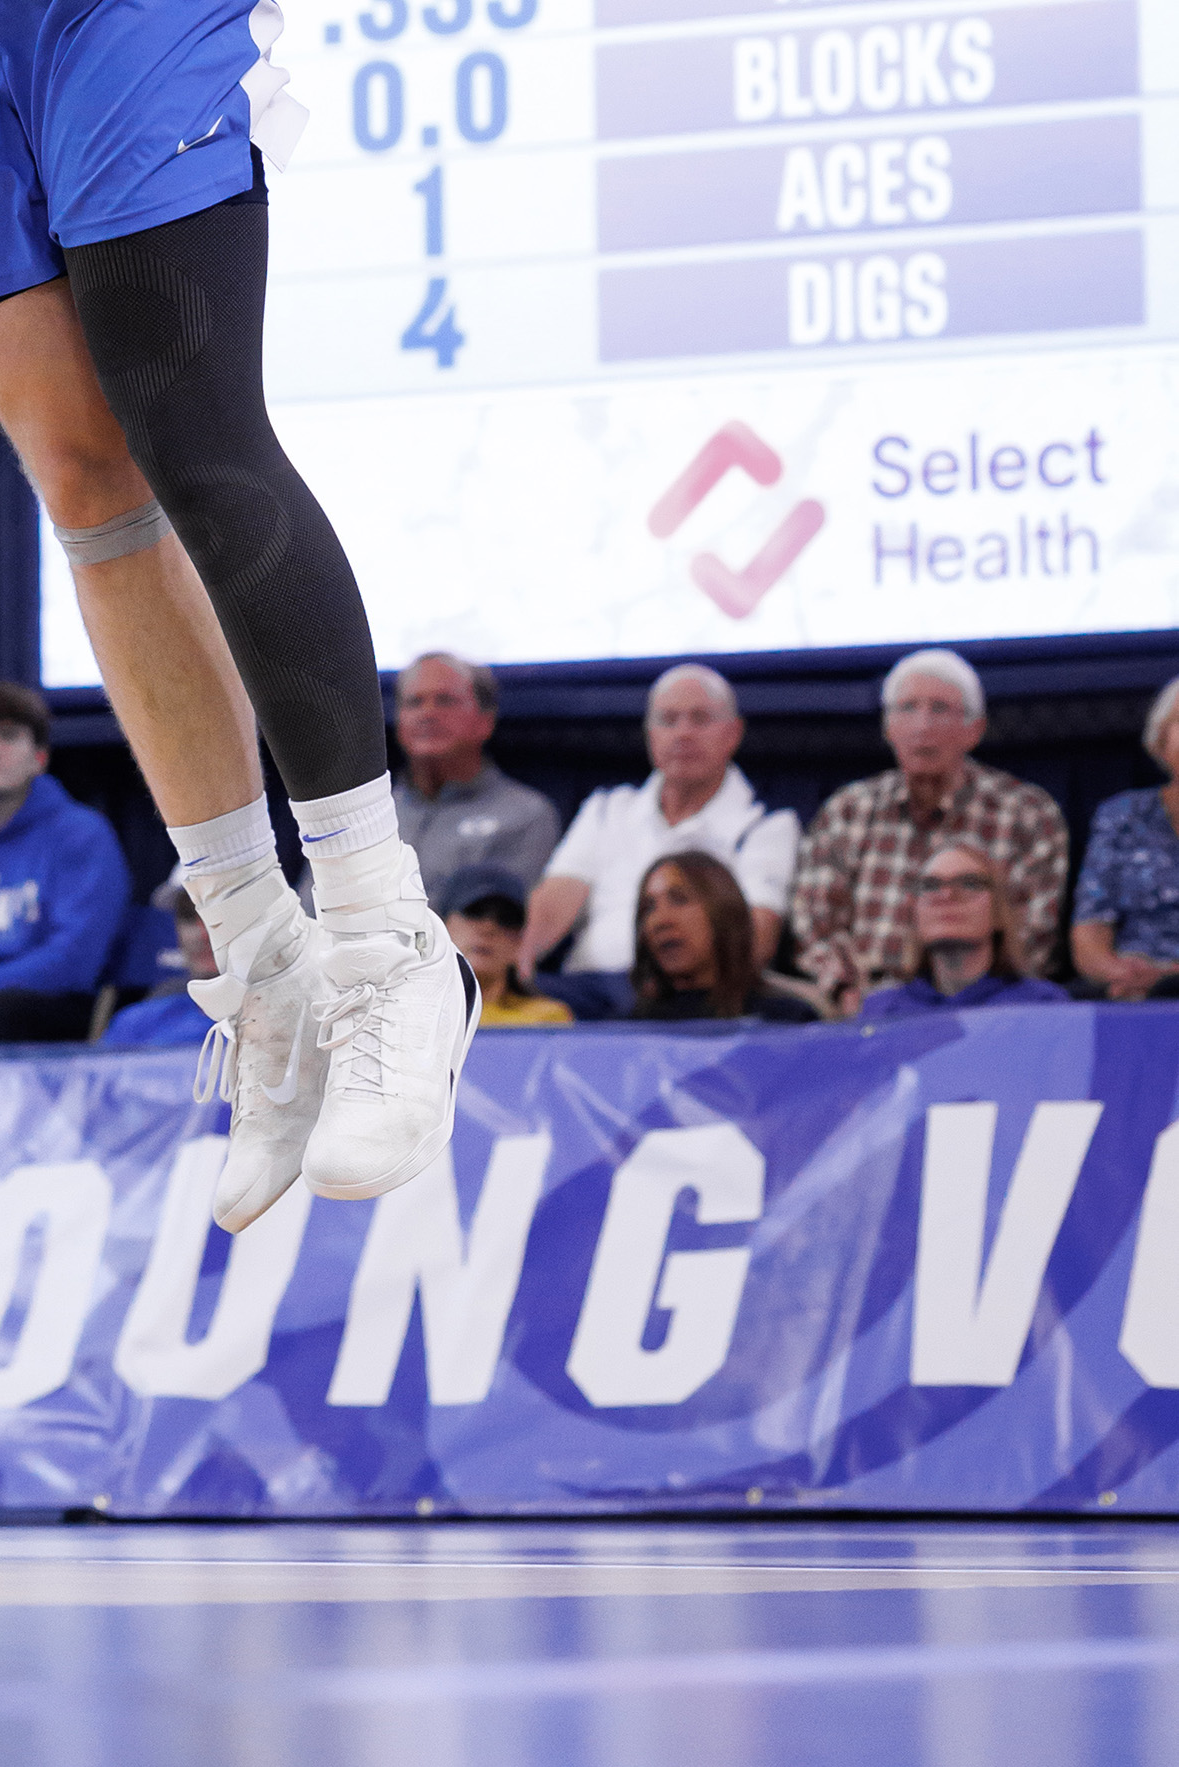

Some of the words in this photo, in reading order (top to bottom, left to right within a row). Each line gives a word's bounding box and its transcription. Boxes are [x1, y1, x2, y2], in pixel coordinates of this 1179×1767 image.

[353, 51, 508, 152] 0.0
[734, 17, 995, 121] BLOCKS
[414, 165, 444, 256] 1
[777, 136, 952, 231] ACES
[400, 277, 465, 370] 4
[789, 253, 948, 346] DIGS
[871, 426, 1107, 499] Select
[873, 512, 1101, 585] Health
